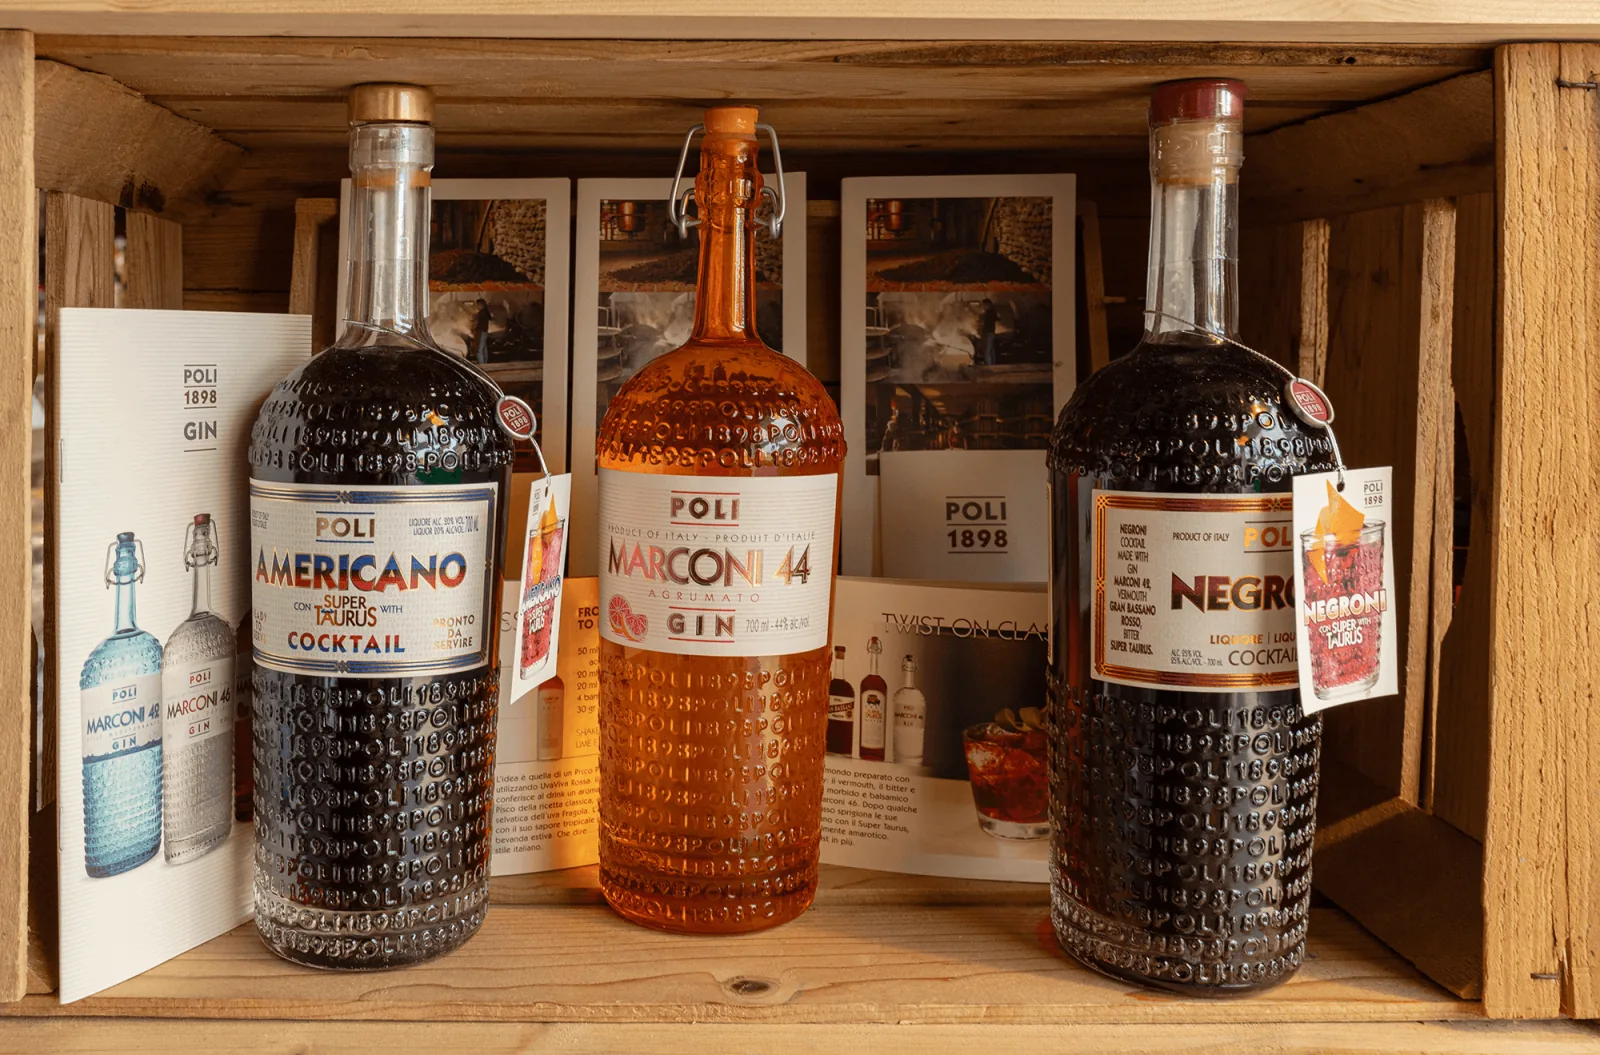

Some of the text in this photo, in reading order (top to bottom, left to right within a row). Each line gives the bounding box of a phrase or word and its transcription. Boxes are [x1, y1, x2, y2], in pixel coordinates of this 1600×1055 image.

[184, 368, 217, 384] POLI
[184, 390, 217, 404] 1898
[1296, 392, 1314, 403] POLI
[503, 406, 522, 420] POLI
[1304, 404, 1322, 413] 1898
[510, 416, 528, 430] 1898
[184, 421, 217, 440] GIN
[1364, 482, 1383, 493] POLI
[1364, 495, 1383, 505] 1898
[670, 497, 740, 520] POLI
[946, 502, 1006, 521] POLI
[316, 517, 375, 538] POLI
[608, 524, 816, 543] PRODUCT OF ITALY PRODUIT D'ITALIE
[1120, 524, 1147, 536] NEGRONI
[948, 529, 1008, 548] 1898
[1120, 536, 1146, 549] COCKTAIL
[1172, 532, 1230, 542] PRODUCT OF ITALY
[1244, 526, 1293, 549] POL
[608, 536, 812, 588] MARCONI 44
[1118, 550, 1149, 562] MADE WITH
[256, 546, 467, 593] AMERICANO
[1127, 564, 1138, 574] GIN
[1114, 576, 1140, 588] MARCONI
[648, 589, 760, 602] AGRUMATO
[1117, 589, 1148, 602] VERMOUTH
[294, 594, 403, 614] CON SUPER WITH
[1110, 601, 1156, 616] GRAN BASSANO
[1304, 588, 1388, 626] NEGRONI
[314, 604, 378, 628] TAURUS
[433, 614, 475, 628] PRONTO
[1121, 615, 1142, 630] ROSSO,
[578, 619, 593, 630] TO
[667, 612, 736, 637] GIN
[746, 618, 759, 632] 700
[882, 612, 945, 636] TWIST
[952, 618, 991, 638] ON
[1332, 618, 1356, 634] SUPER
[448, 629, 462, 638] DA
[1123, 628, 1140, 640] BITTER
[1210, 632, 1296, 645] LIQUORE LIQU
[1326, 626, 1362, 650] TAURUS
[288, 631, 405, 654] COCKTAIL
[434, 637, 472, 650] SERVIRE
[1110, 640, 1154, 655] SUPER TAURUS.
[578, 647, 588, 655] 50
[189, 672, 211, 684] POLI
[112, 689, 137, 700] POLI
[167, 690, 218, 720] MARCONI
[87, 706, 145, 735] MARCONI
[188, 720, 210, 735] GIN
[112, 736, 137, 750] GIN
[496, 775, 518, 783] L'idea
[528, 772, 552, 781] quella
[554, 770, 561, 778] di
[854, 772, 892, 781] preparato
[496, 784, 538, 793] utilizzando
[540, 780, 568, 789] UvaViva
[886, 784, 908, 792] bitter
[496, 794, 535, 803] conferisce
[538, 792, 544, 800] al
[546, 790, 565, 799] drink
[827, 788, 860, 797] morbido
[870, 792, 908, 802] balsamico
[518, 803, 537, 811] della
[540, 801, 563, 810] ricetta
[862, 801, 884, 810] Dopo
[886, 804, 918, 813] qualche
[496, 815, 528, 824] selvatica
[531, 812, 560, 821] dell'uva
[838, 809, 872, 818] sprigiona
[535, 822, 561, 831] sapore
[563, 817, 594, 827] tropicale
[858, 820, 880, 829] Super
[884, 822, 909, 833] Taurus,
[496, 835, 528, 844] bevanda
[557, 830, 570, 838] Che
[495, 846, 511, 854] stile
